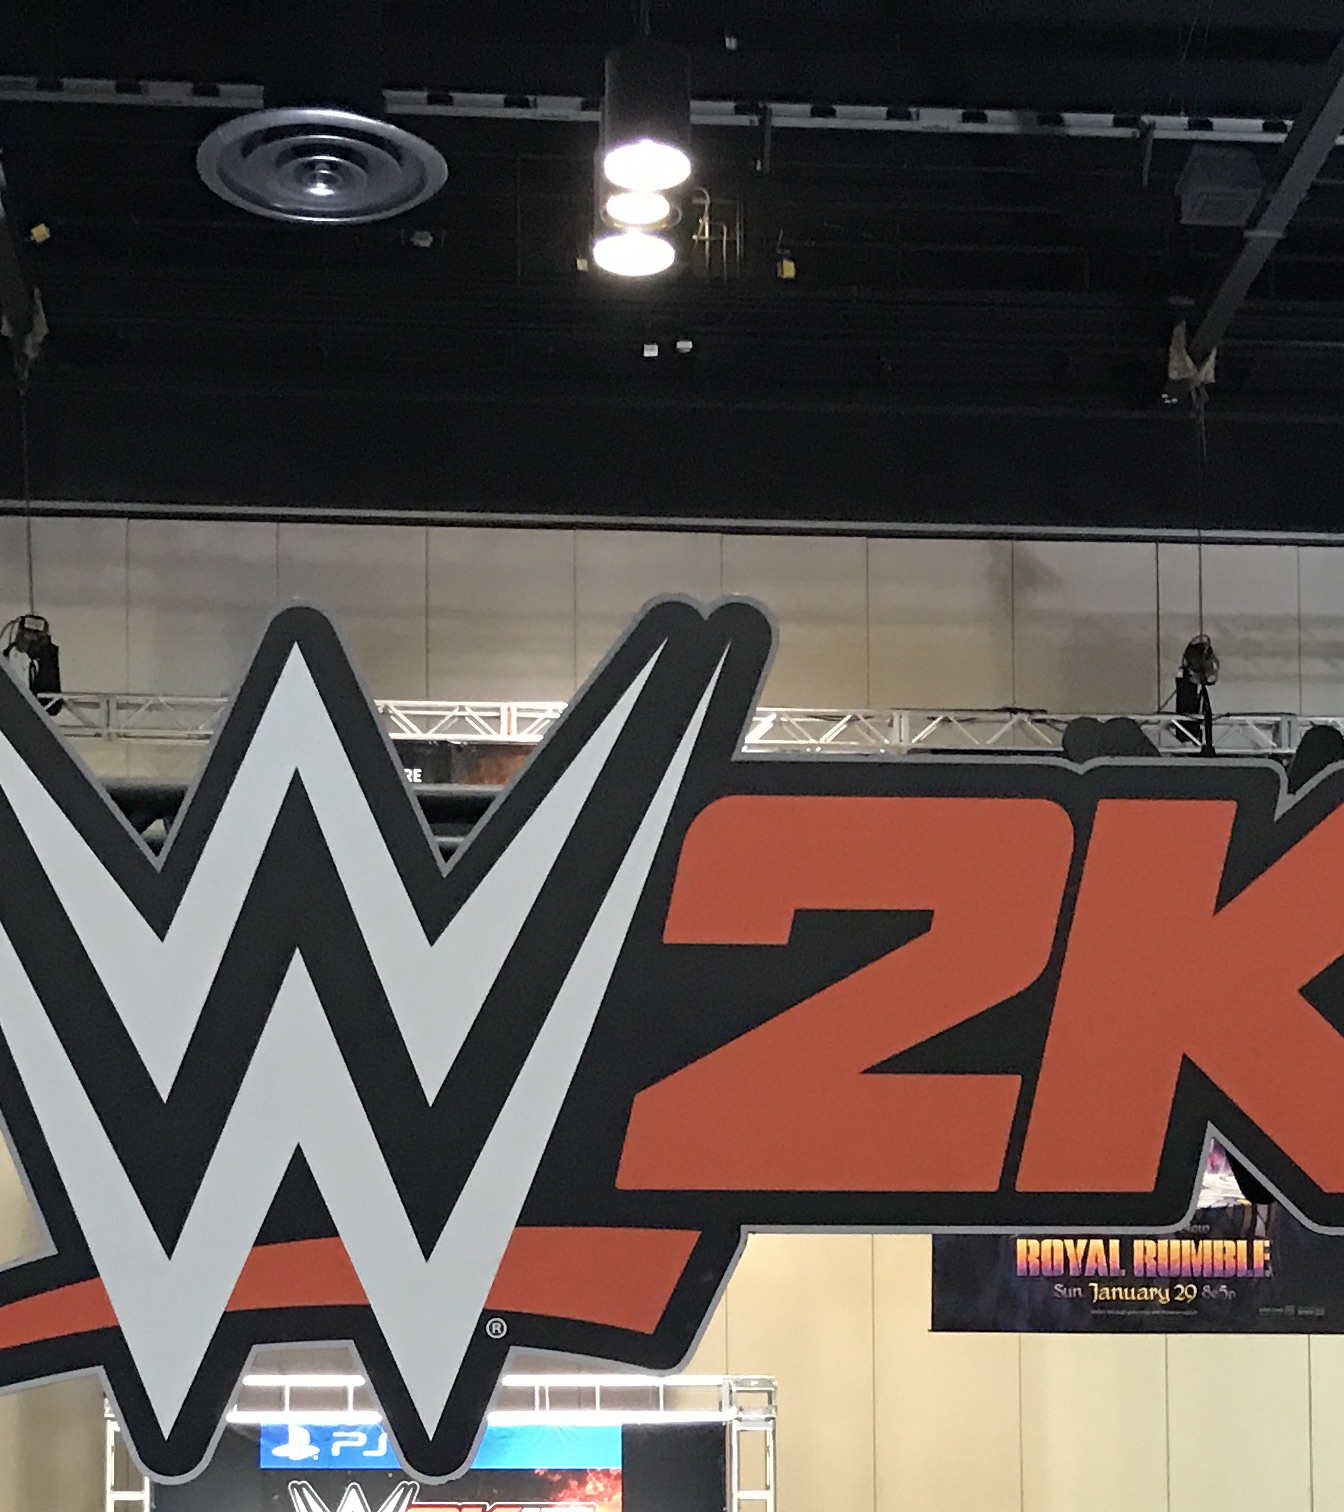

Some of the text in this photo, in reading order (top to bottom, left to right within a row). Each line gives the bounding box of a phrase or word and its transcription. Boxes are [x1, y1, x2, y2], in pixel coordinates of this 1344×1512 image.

[1016, 1238, 1274, 1278] ROYAL RUMBLE
[1088, 1282, 1171, 1305] January
